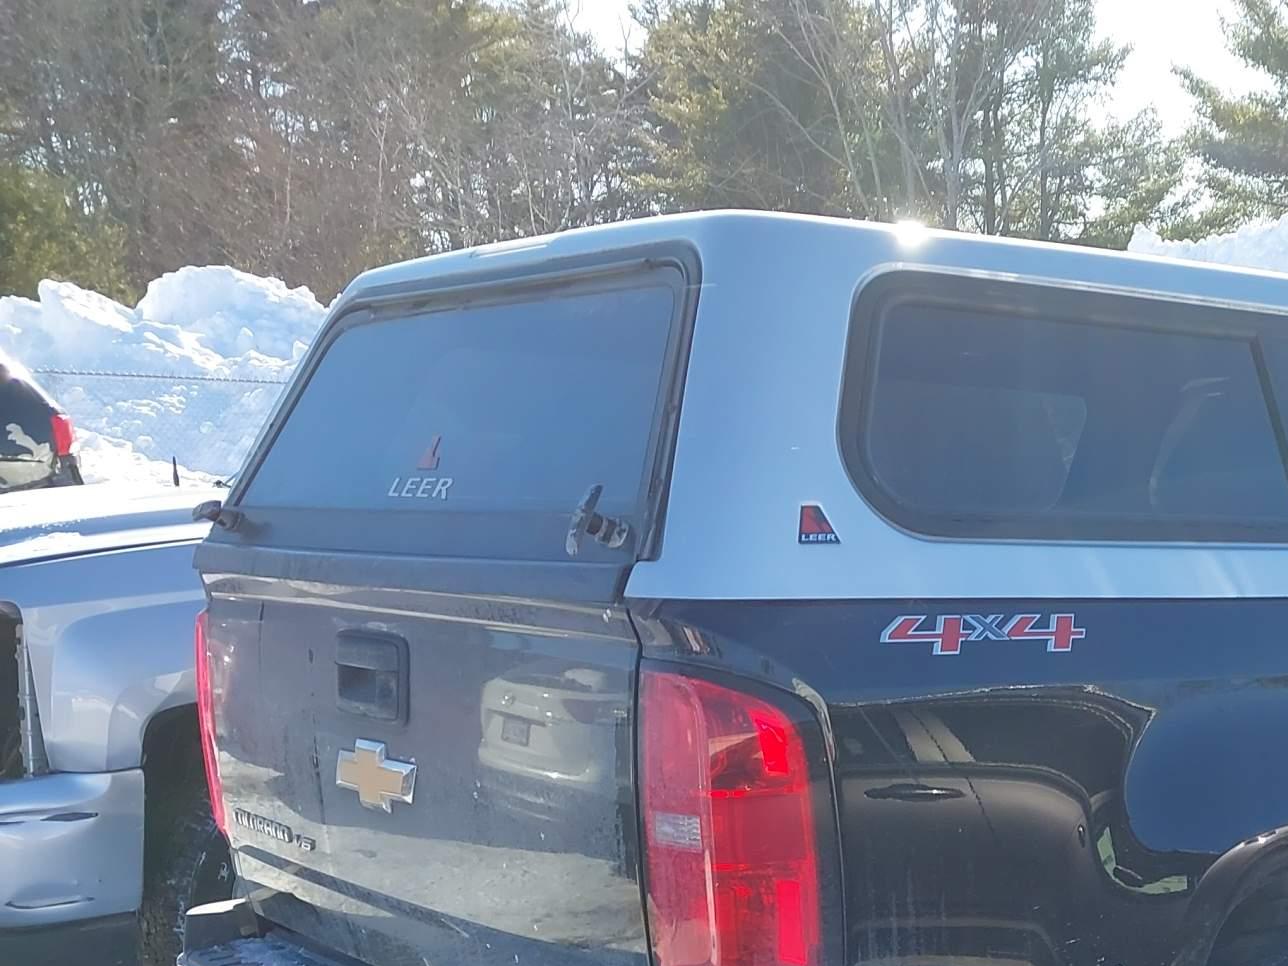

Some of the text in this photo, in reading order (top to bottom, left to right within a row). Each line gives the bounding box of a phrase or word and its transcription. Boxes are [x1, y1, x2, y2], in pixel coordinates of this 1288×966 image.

[387, 477, 454, 500] LEER
[801, 532, 837, 541] LEER
[232, 807, 316, 851] COLORADO V6
